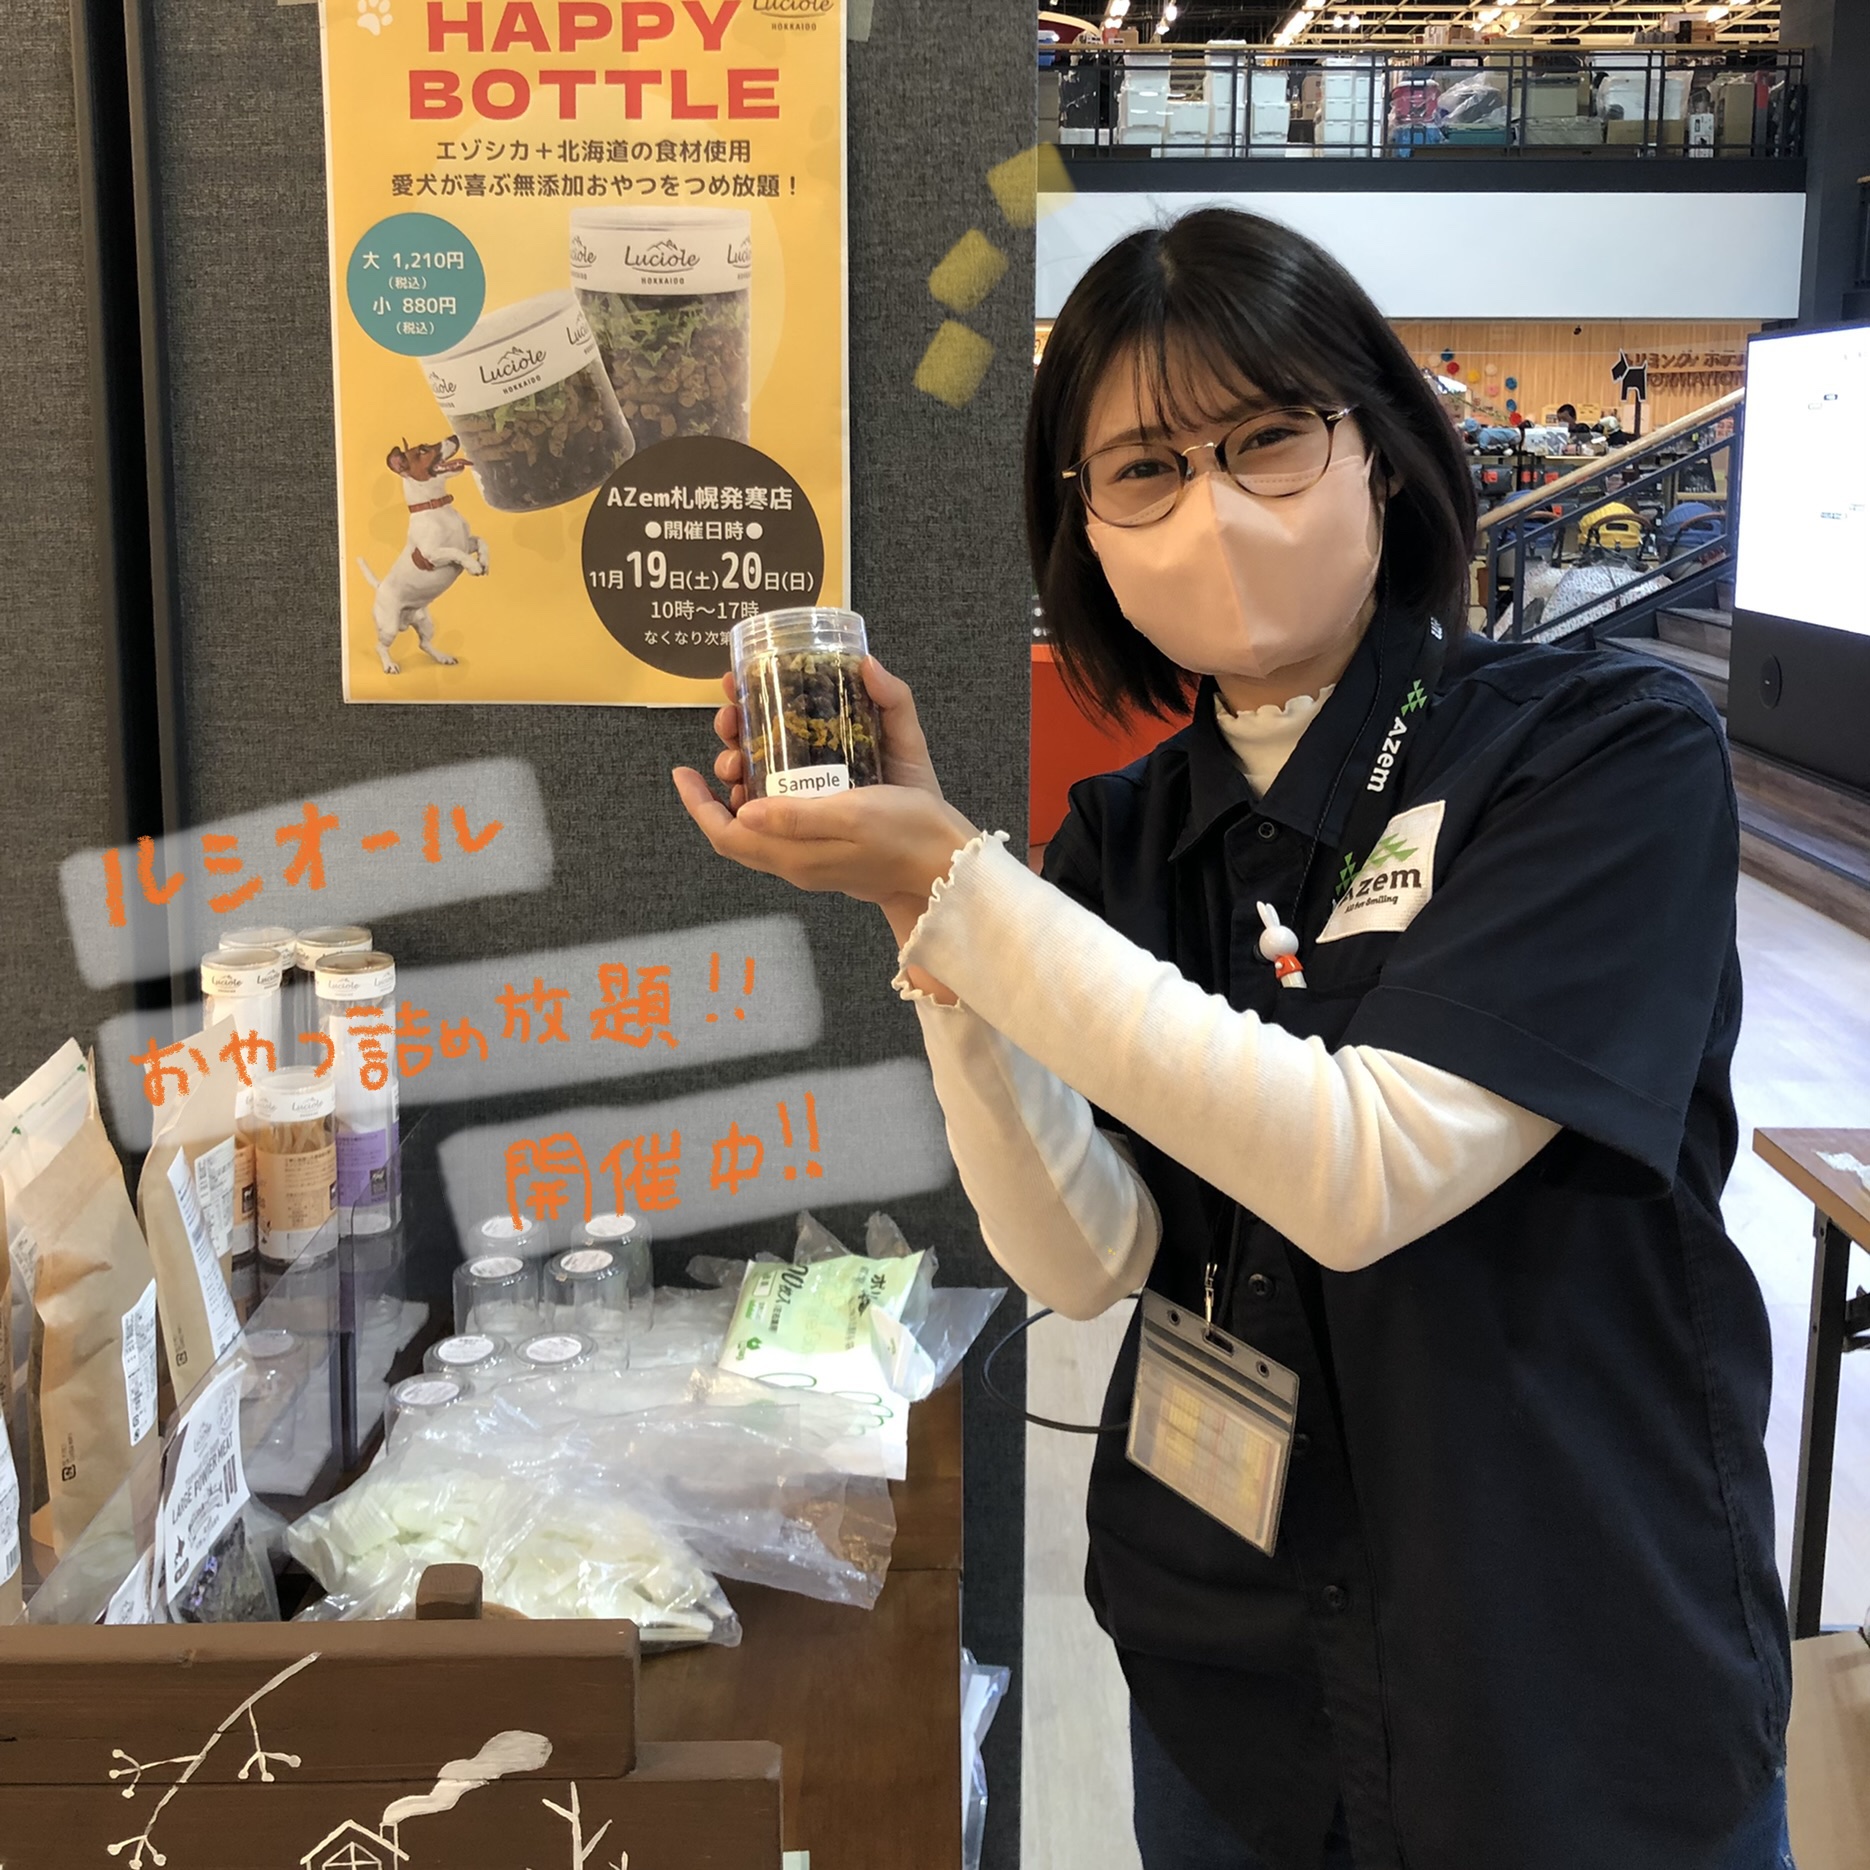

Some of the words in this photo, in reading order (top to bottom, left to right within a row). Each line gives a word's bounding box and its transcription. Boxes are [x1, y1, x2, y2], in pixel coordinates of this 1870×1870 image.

[427, 0, 742, 53] HAPPY
[771, 22, 817, 31] HOKKAIDO
[408, 68, 780, 120] BOTTLE
[436, 138, 751, 163] エゾシカ＋北海道の食材使用
[391, 173, 796, 197] 愛犬が喜ぶ無添加おやつをつめ放題！
[362, 251, 380, 269] 大
[393, 251, 464, 270] 1,210円
[624, 245, 701, 267] Luciole
[641, 277, 685, 285] HOKKAIDO
[372, 296, 391, 315] 小
[402, 296, 456, 315] 880円
[479, 350, 547, 384] Luciole
[502, 374, 542, 395] HOKKAIDO
[606, 486, 793, 511] AZem札幌発寒店
[1366, 716, 1408, 793] Azem
[778, 772, 840, 794] Sample
[1340, 868, 1422, 906] Azem
